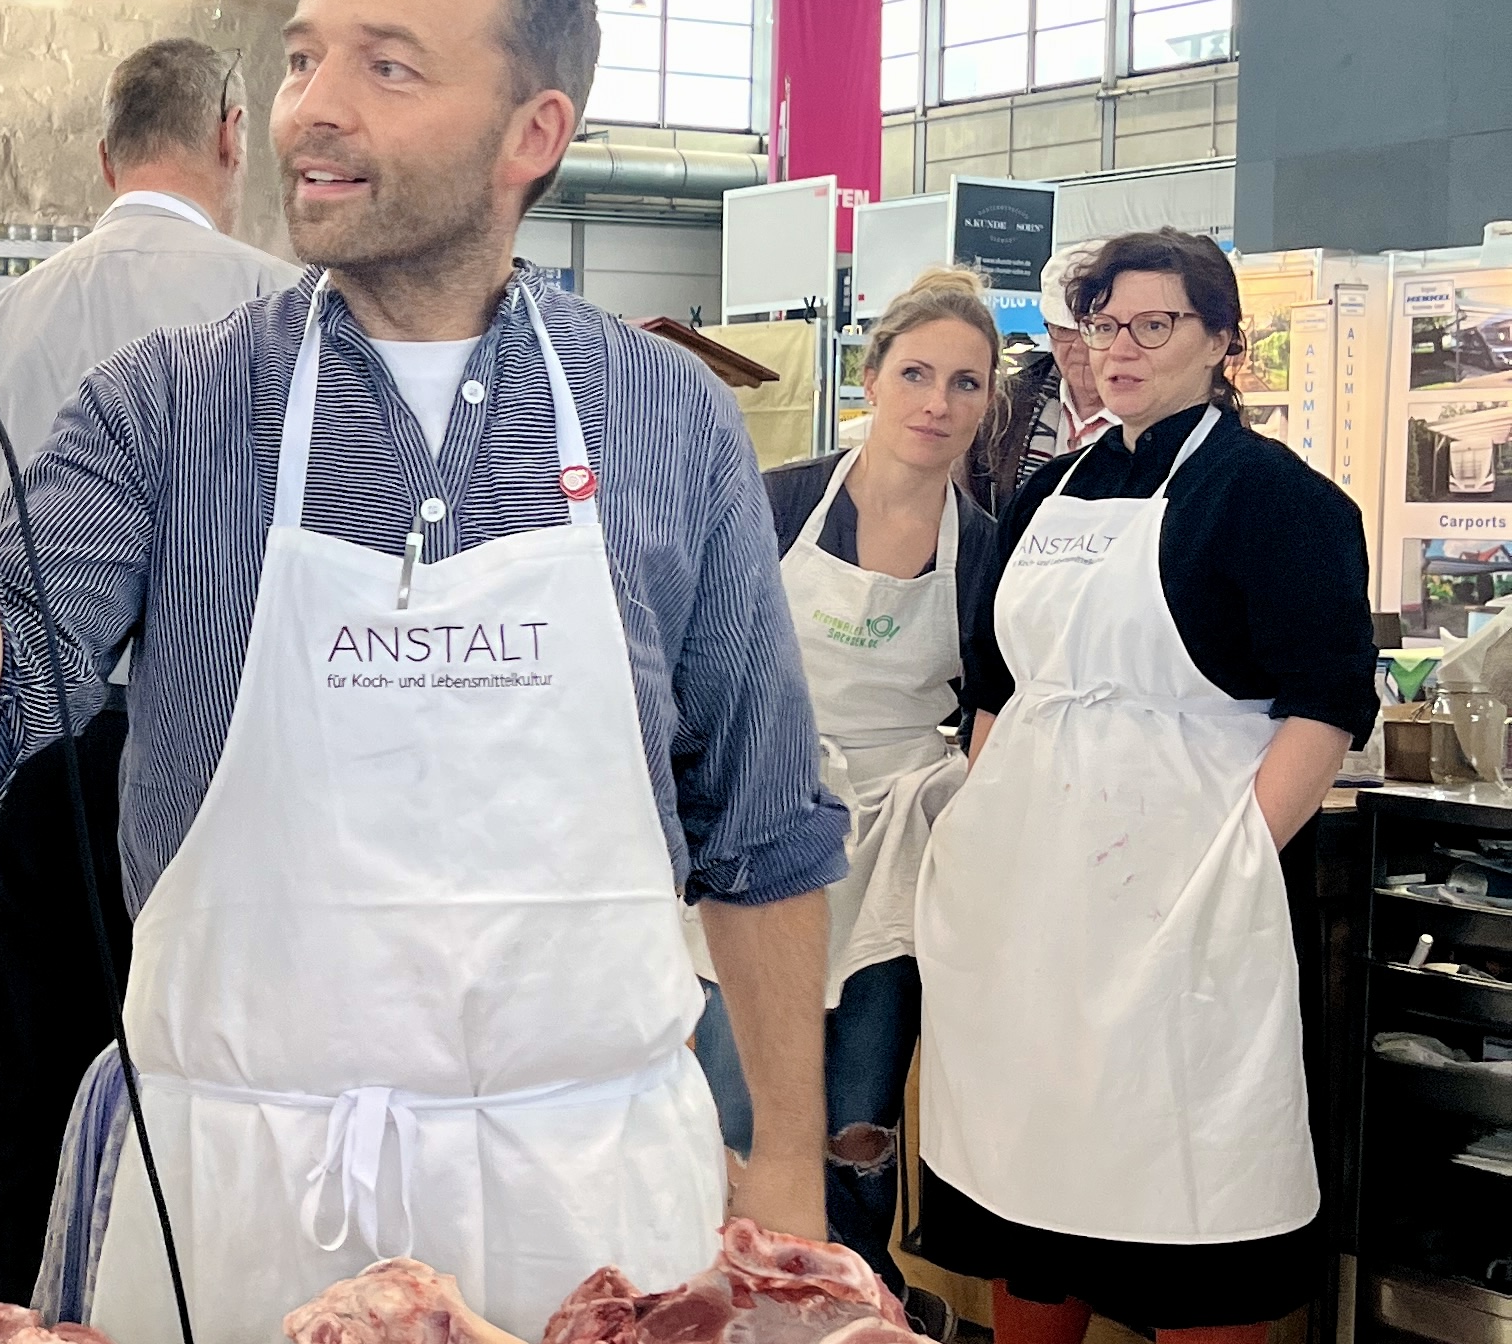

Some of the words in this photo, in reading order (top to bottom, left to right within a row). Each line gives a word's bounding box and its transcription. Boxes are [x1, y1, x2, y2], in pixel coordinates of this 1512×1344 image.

[1439, 514, 1507, 531] Carports
[327, 622, 549, 664] ANSTALT
[326, 673, 346, 689] für
[351, 673, 395, 689] Koch-
[398, 673, 426, 689] und
[430, 671, 554, 689] Lebensmittelkultur
